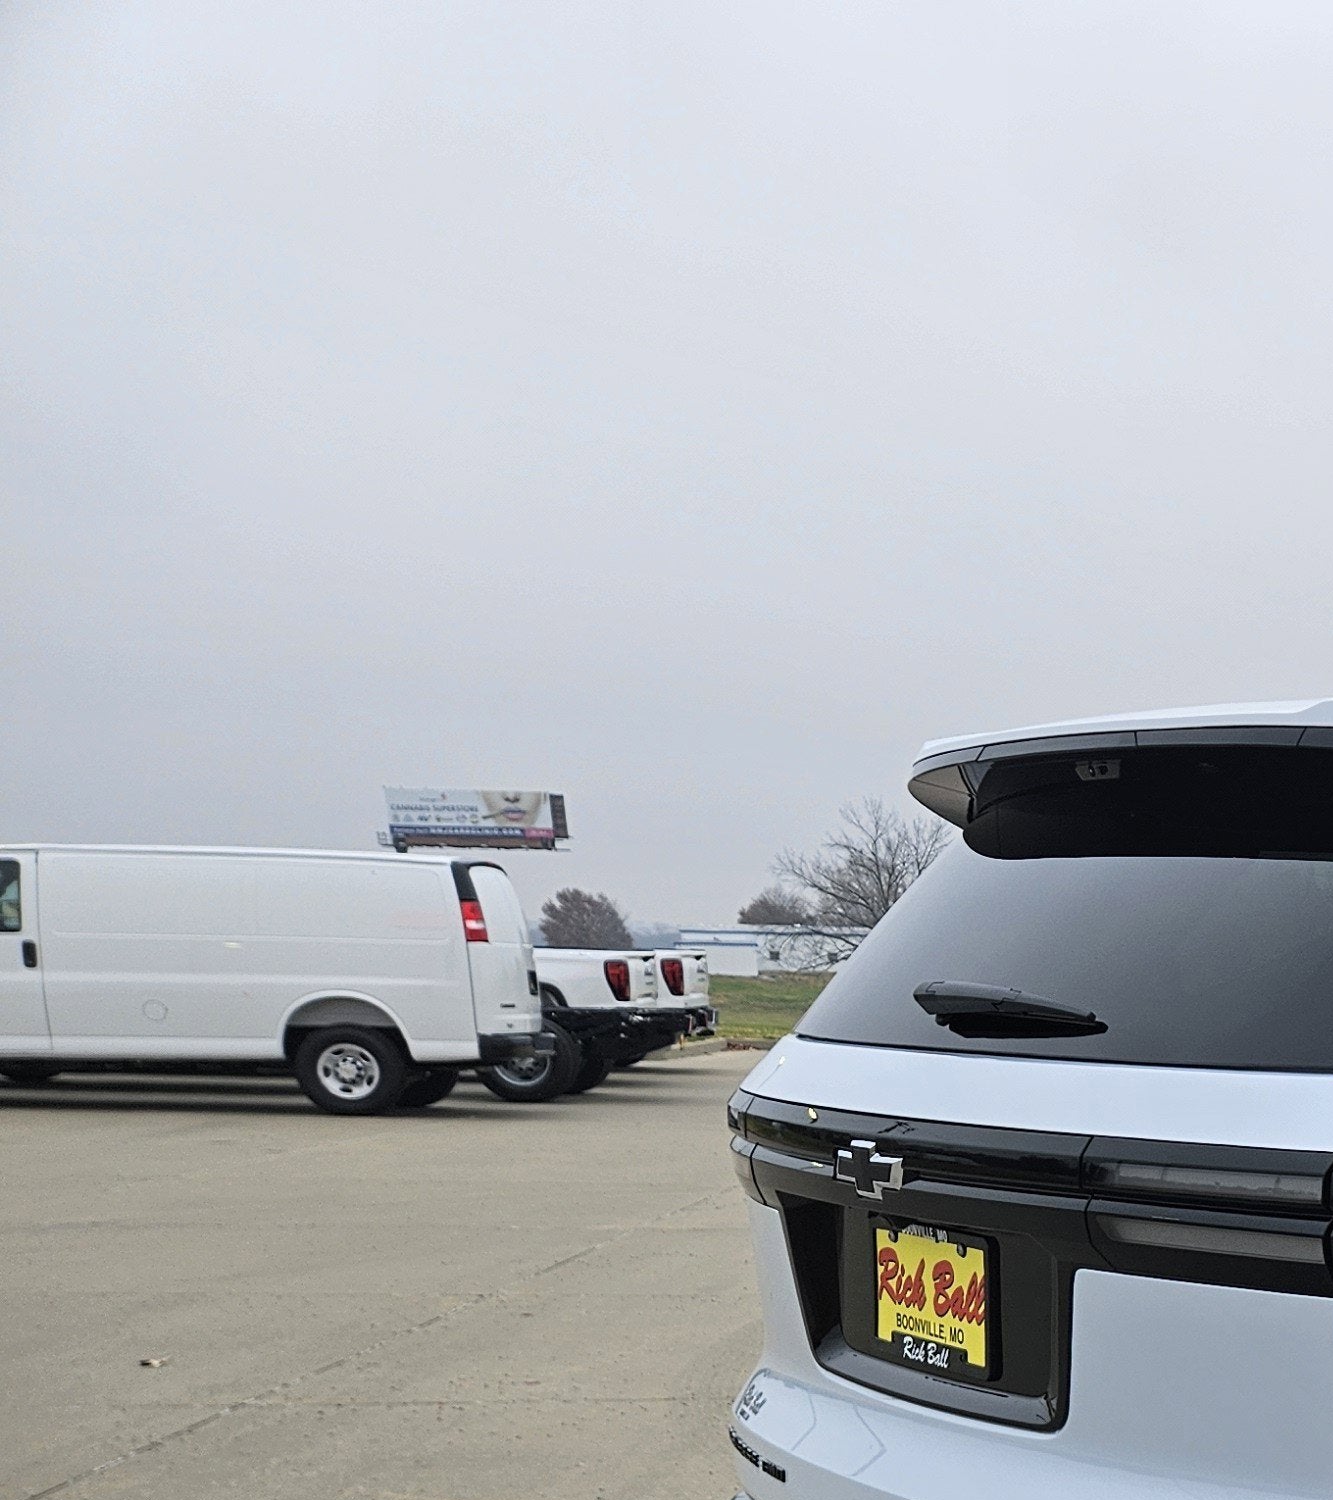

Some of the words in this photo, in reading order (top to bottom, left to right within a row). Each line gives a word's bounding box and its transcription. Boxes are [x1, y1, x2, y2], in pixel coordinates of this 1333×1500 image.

[879, 1247, 926, 1311] Rick
[932, 1260, 985, 1326] Ball
[896, 1313, 947, 1344] BOONVILLE,
[949, 1326, 964, 1344] MO
[903, 1336, 926, 1363] Rick
[926, 1343, 949, 1369] Ball
